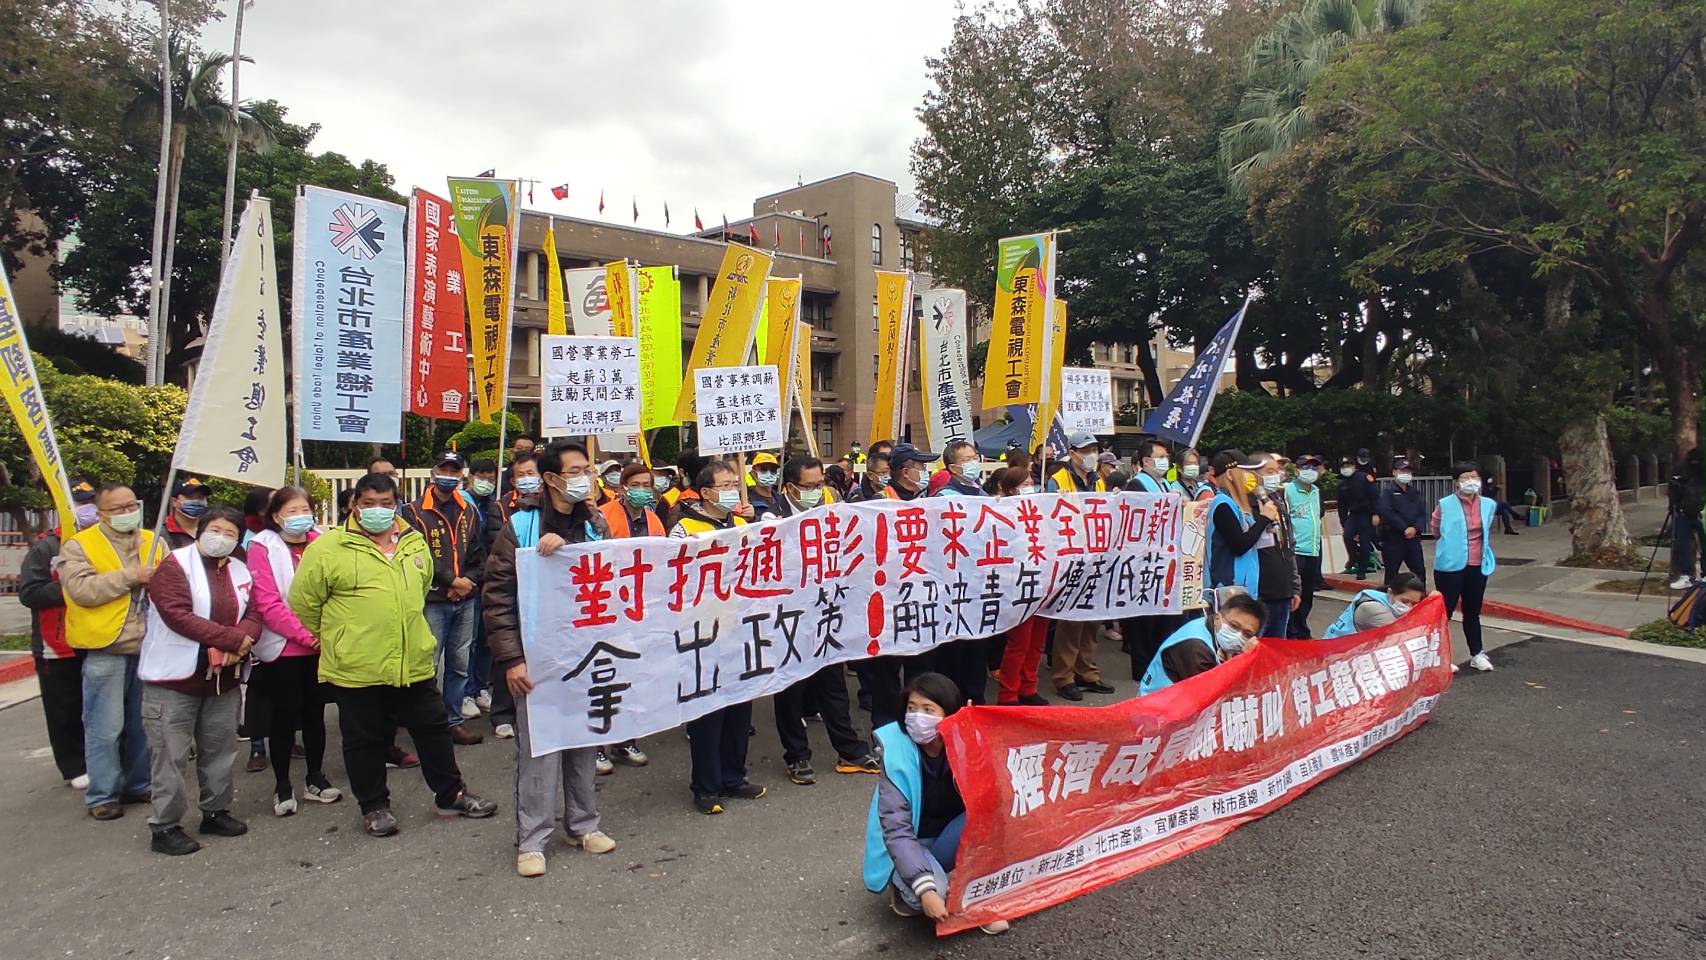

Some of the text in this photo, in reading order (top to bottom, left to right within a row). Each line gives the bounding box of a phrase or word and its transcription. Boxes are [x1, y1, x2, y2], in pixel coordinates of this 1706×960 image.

[416, 199, 440, 408] 國家表演藝術中心
[481, 232, 501, 408] 東森電視工會
[1005, 274, 1030, 399] 東森電視工會
[551, 344, 636, 361] 國營事業勞工
[566, 368, 623, 385] 起薪3萬
[701, 372, 774, 389] 國營事業調薪
[551, 386, 636, 402] 鼓勵民間企業
[566, 409, 623, 425] 比照辦理
[703, 408, 777, 428] 鼓勵民間企業
[718, 430, 767, 447] 比照辦理
